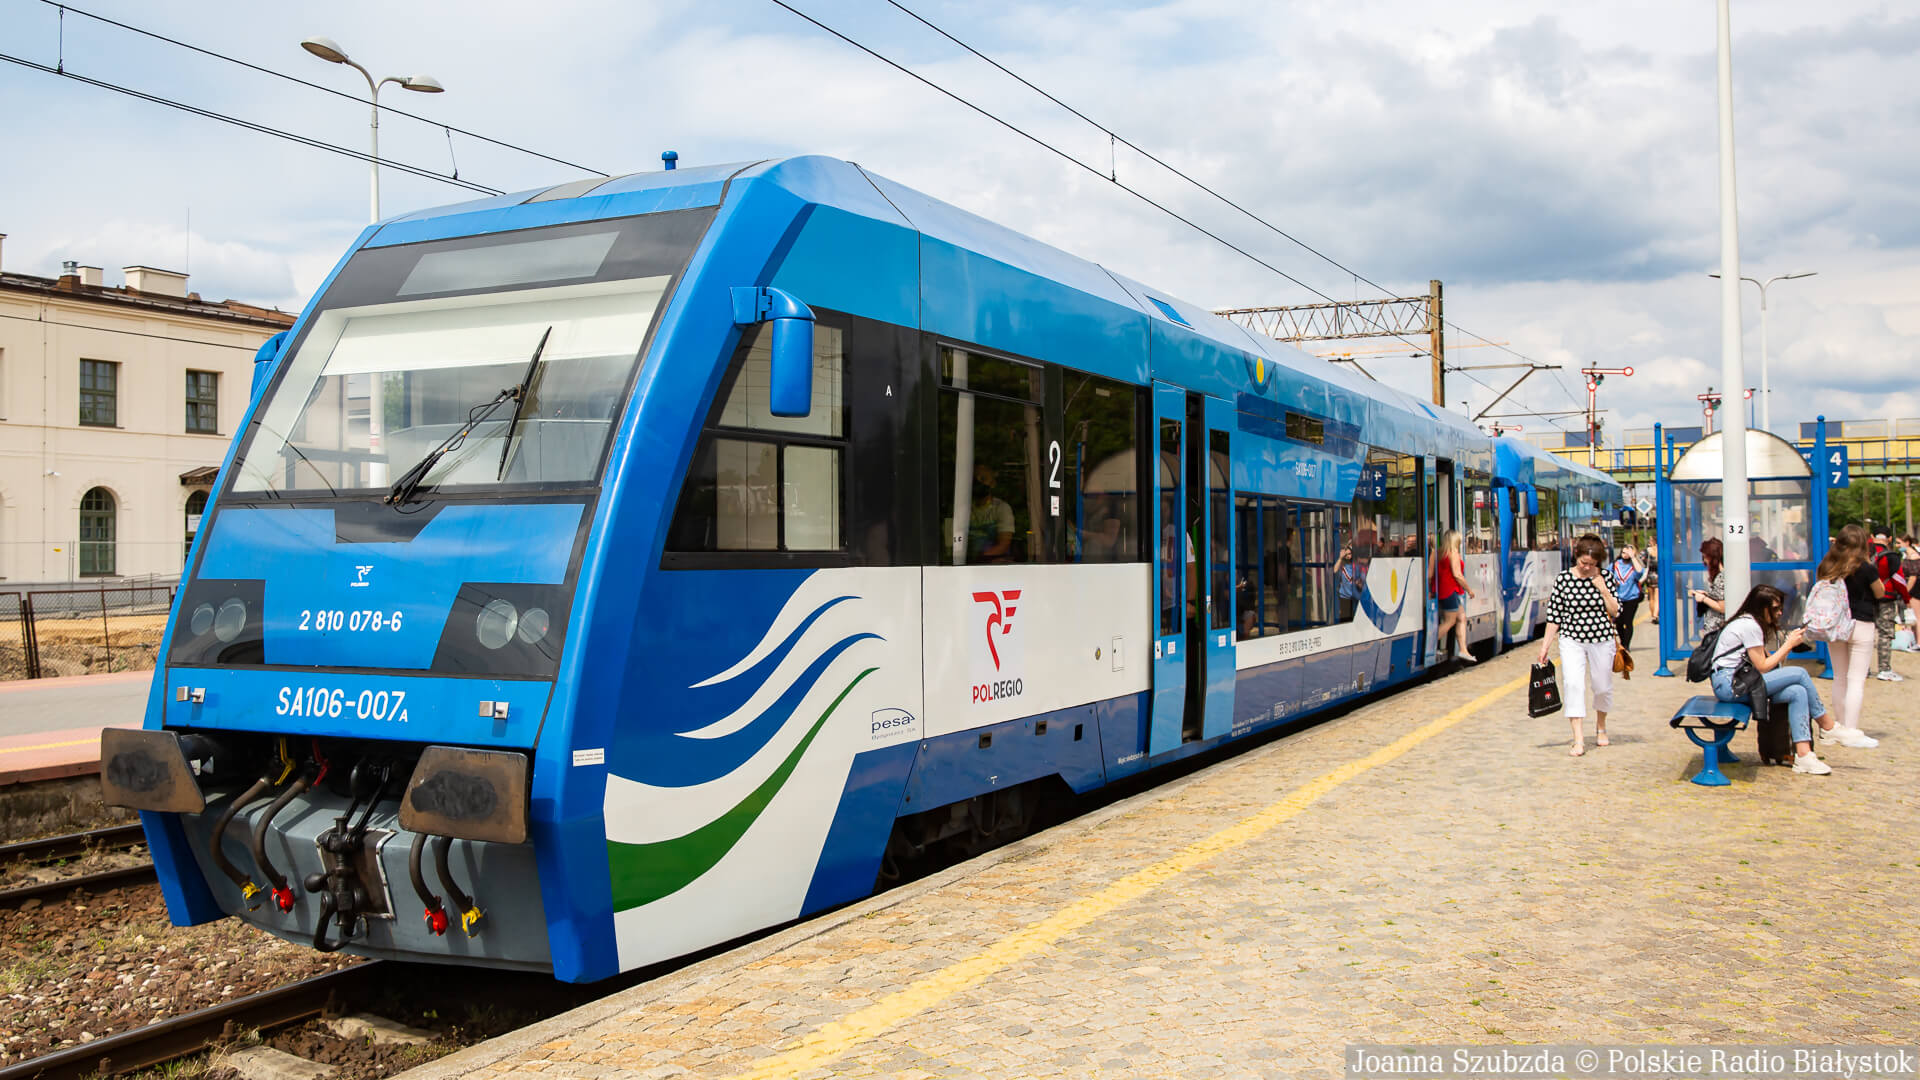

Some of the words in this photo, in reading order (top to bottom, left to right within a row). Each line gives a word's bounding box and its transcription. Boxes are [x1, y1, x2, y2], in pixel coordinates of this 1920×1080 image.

[884, 384, 893, 397] A
[1049, 440, 1062, 490] 2
[1830, 451, 1843, 466] 4
[1831, 471, 1842, 485] 7
[299, 609, 311, 631] 2
[315, 610, 344, 631] 810
[349, 610, 403, 632] 078-6
[972, 678, 1023, 704] POLREGIO
[871, 716, 911, 734] pesa
